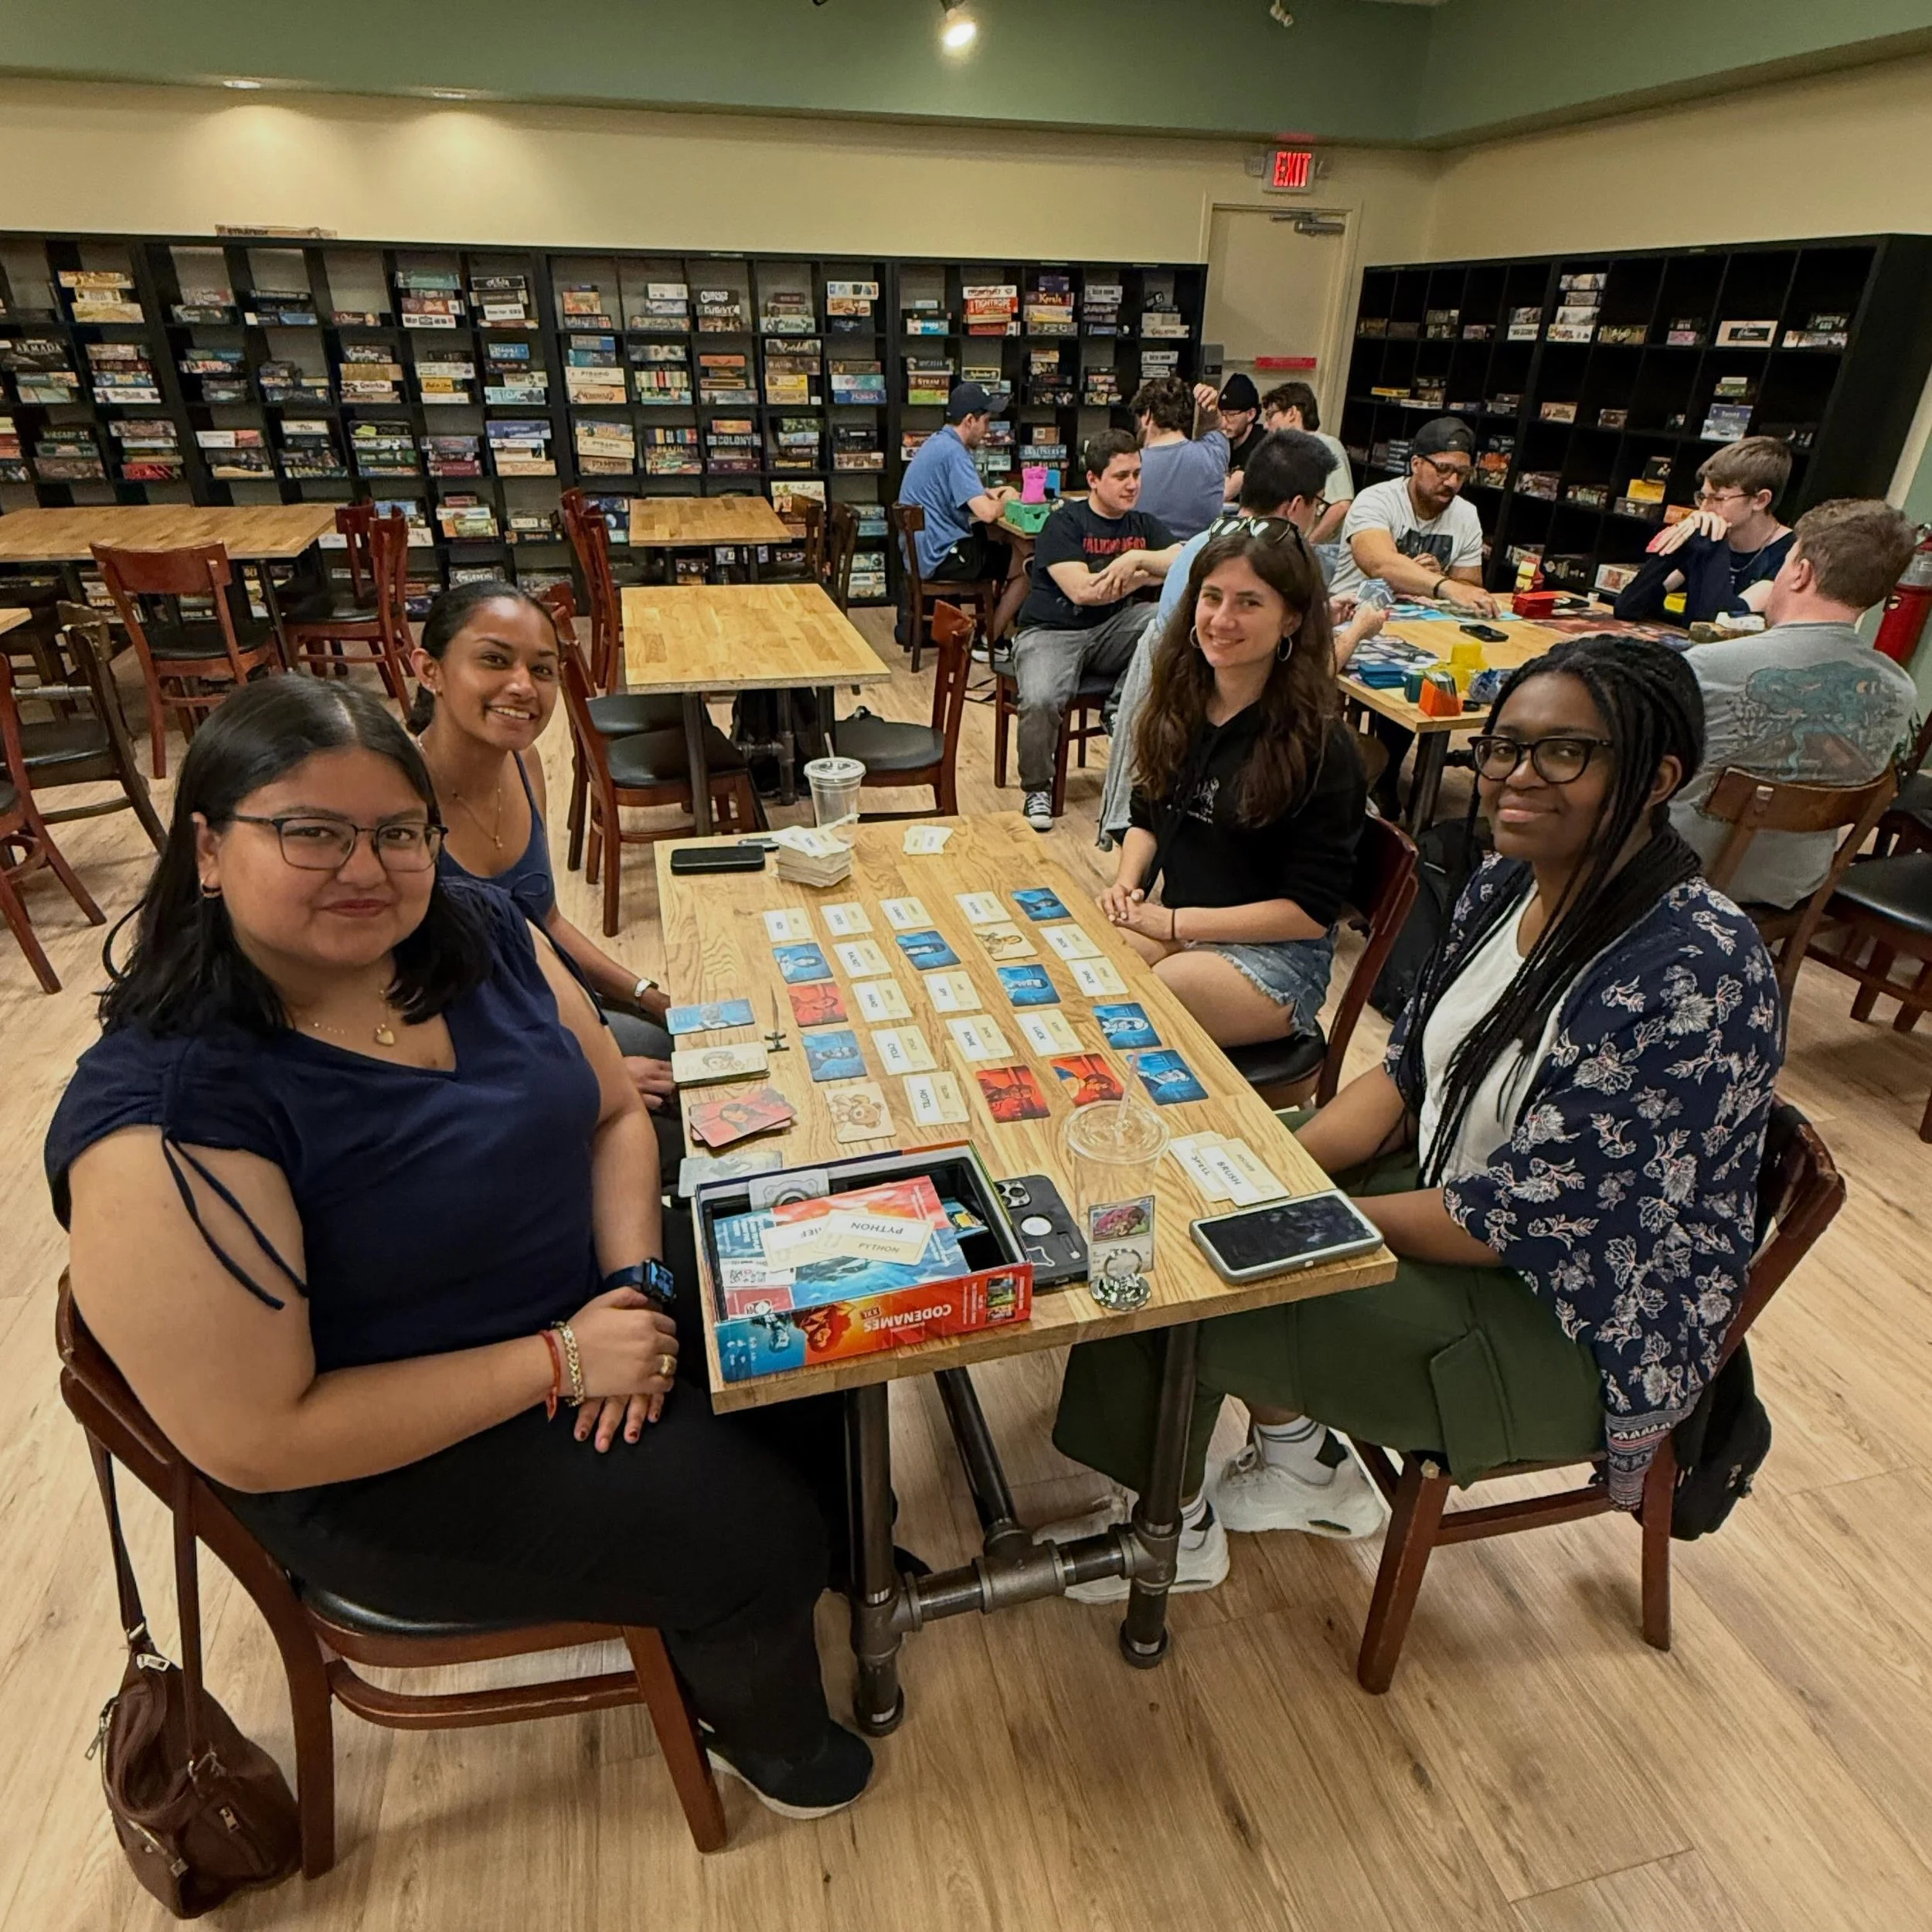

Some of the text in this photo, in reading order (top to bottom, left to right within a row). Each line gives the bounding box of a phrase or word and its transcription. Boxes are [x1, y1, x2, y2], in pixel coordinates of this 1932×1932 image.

[1273, 151, 1312, 187] EXIT
[15, 342, 63, 354] ARMADA
[718, 434, 753, 447] COLONY
[937, 987, 947, 997] SPY
[866, 993, 879, 1009] HAND
[1032, 1026, 1047, 1041] LUCK
[887, 1042, 900, 1059] CYCLE
[918, 1089, 931, 1109] HOTEL
[1191, 1155, 1211, 1176] SPELL
[1216, 1160, 1243, 1185] BRUSH
[850, 1222, 904, 1235] PYTHON
[858, 1242, 901, 1253] PYTHON
[862, 1303, 952, 1333] CODENAMES
